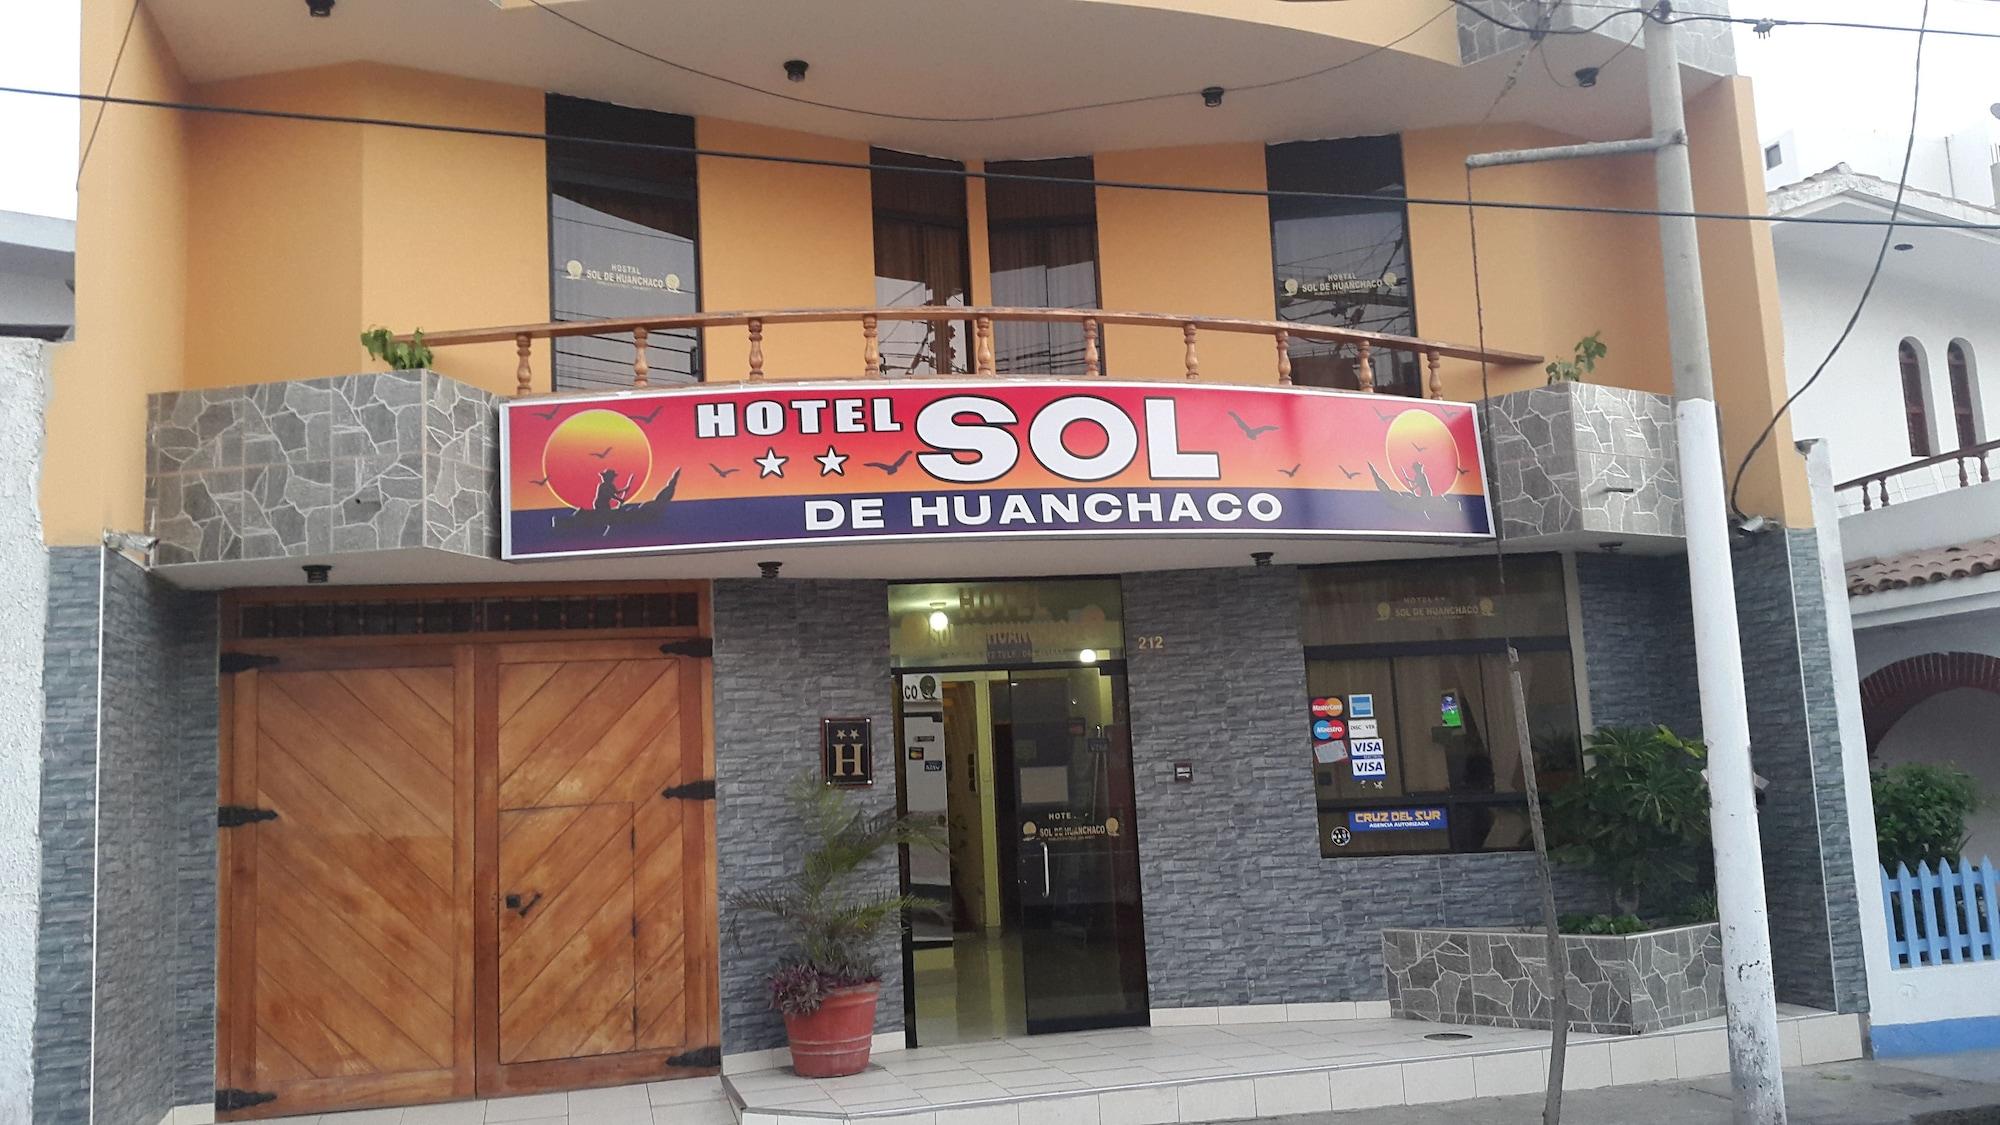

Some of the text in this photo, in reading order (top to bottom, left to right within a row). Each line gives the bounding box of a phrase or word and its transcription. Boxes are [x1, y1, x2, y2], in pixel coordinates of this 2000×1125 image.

[611, 263, 641, 275] HOSTAL
[586, 269, 602, 281] SOL
[604, 272, 616, 282] DE
[616, 273, 664, 289] HUANCHACO
[1301, 283, 1318, 293] SOL
[1320, 282, 1331, 292] DE
[1331, 279, 1383, 291] HUANCHACO
[695, 394, 1222, 484] HOTEL SOL
[804, 492, 1283, 531] DE HUANCHACO
[1394, 605, 1479, 617] SOL DE HUANCHACO
[1138, 635, 1164, 650] 212
[1353, 742, 1382, 752] VISA
[832, 743, 865, 777] H
[1355, 761, 1384, 772] VISA
[1354, 809, 1441, 823] CRUZ DEL SUR
[1039, 827, 1053, 837] SOL
[1064, 825, 1105, 836] HUANCHACO
[1393, 820, 1430, 829] AUTORIZADA
